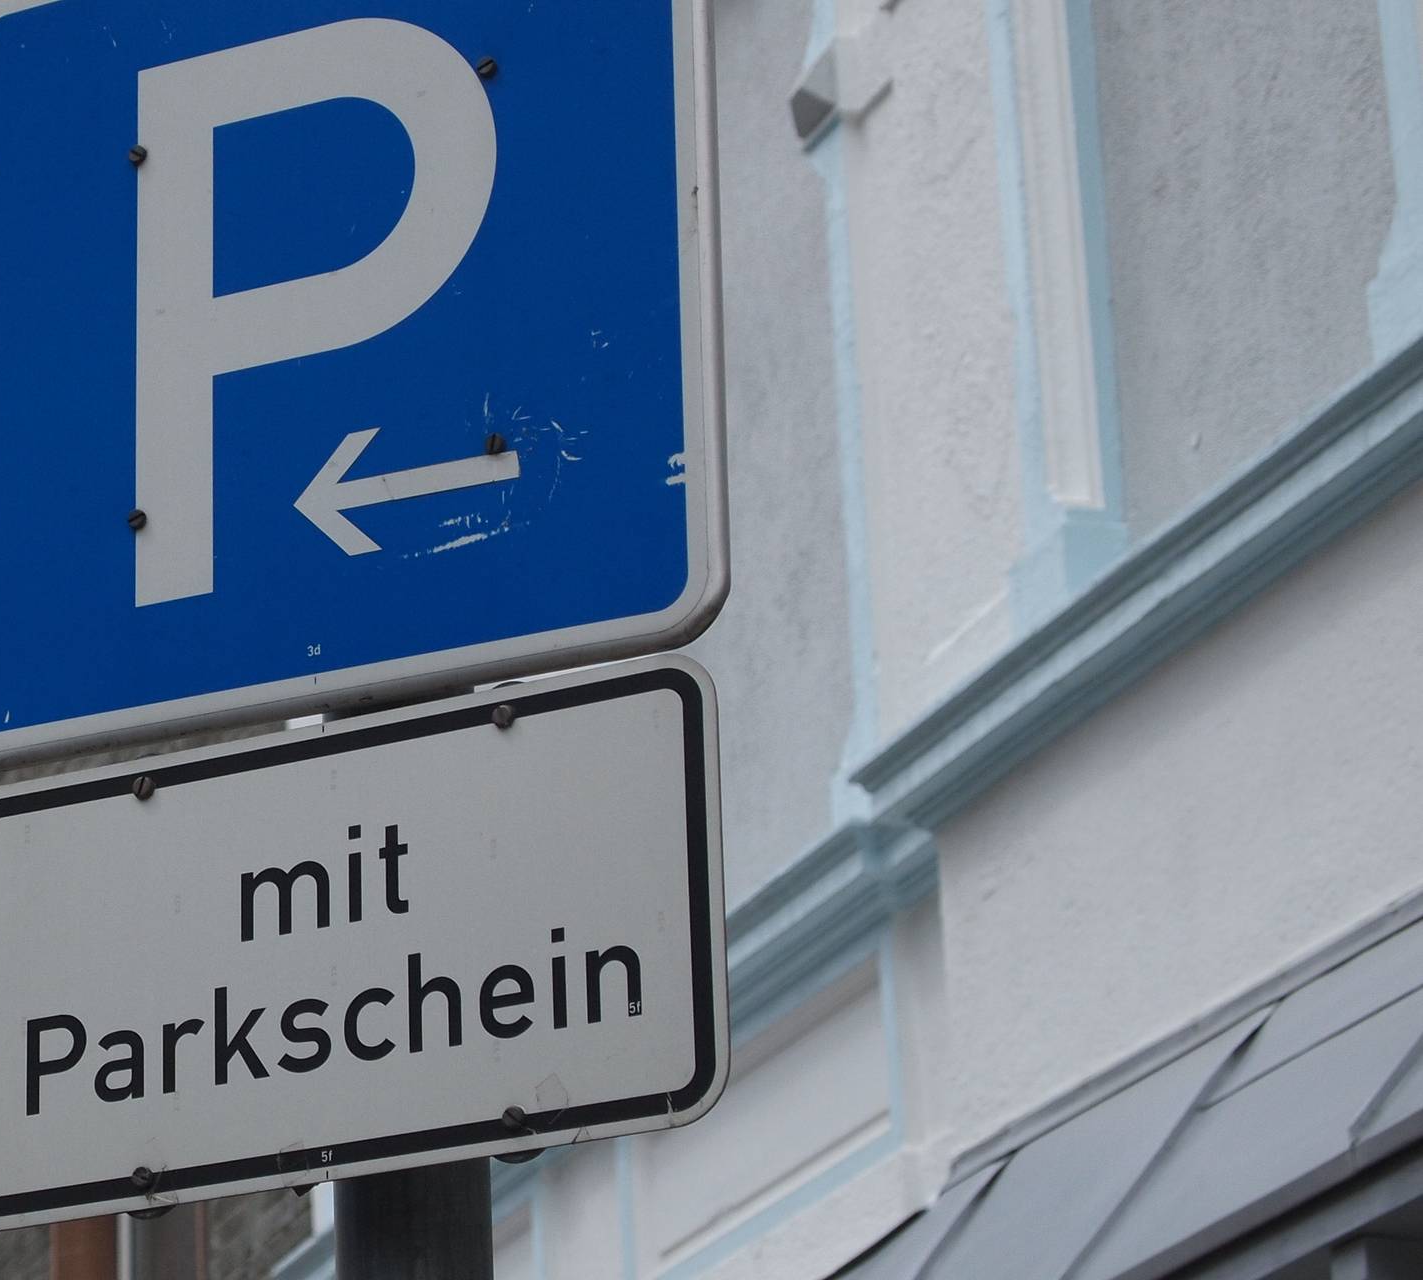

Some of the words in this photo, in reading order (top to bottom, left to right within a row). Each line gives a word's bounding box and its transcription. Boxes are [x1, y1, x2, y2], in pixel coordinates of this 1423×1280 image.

[135, 17, 497, 607] P
[307, 643, 321, 657] 3d
[241, 824, 409, 942] mit
[26, 927, 642, 1116] Parkschein
[629, 1001, 641, 1014] 5f
[321, 1150, 333, 1162] 5f
